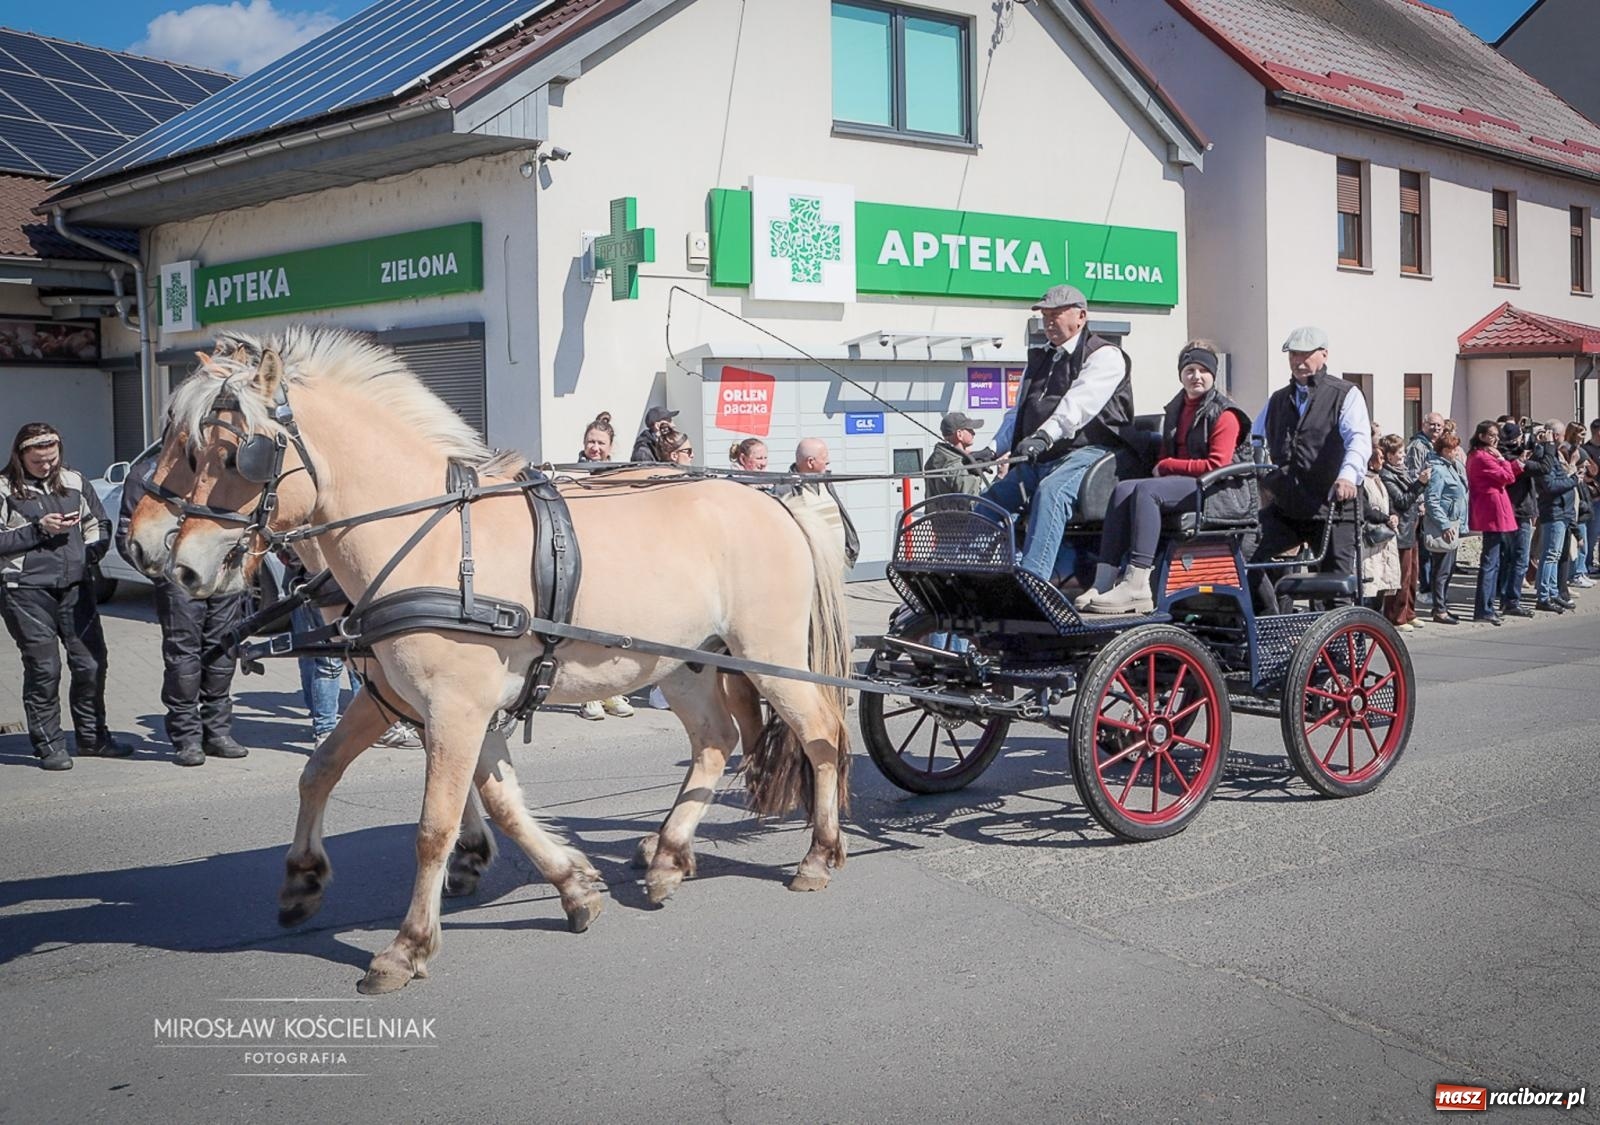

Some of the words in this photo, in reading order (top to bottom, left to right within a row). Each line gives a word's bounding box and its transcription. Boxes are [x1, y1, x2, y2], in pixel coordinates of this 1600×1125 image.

[877, 230, 1050, 275] APTEKA
[1084, 262, 1164, 284] ZIELONA
[204, 267, 291, 308] APTEKA
[380, 252, 458, 284] ZIELONA
[723, 389, 767, 402] ORLEN
[724, 404, 767, 416] paczka
